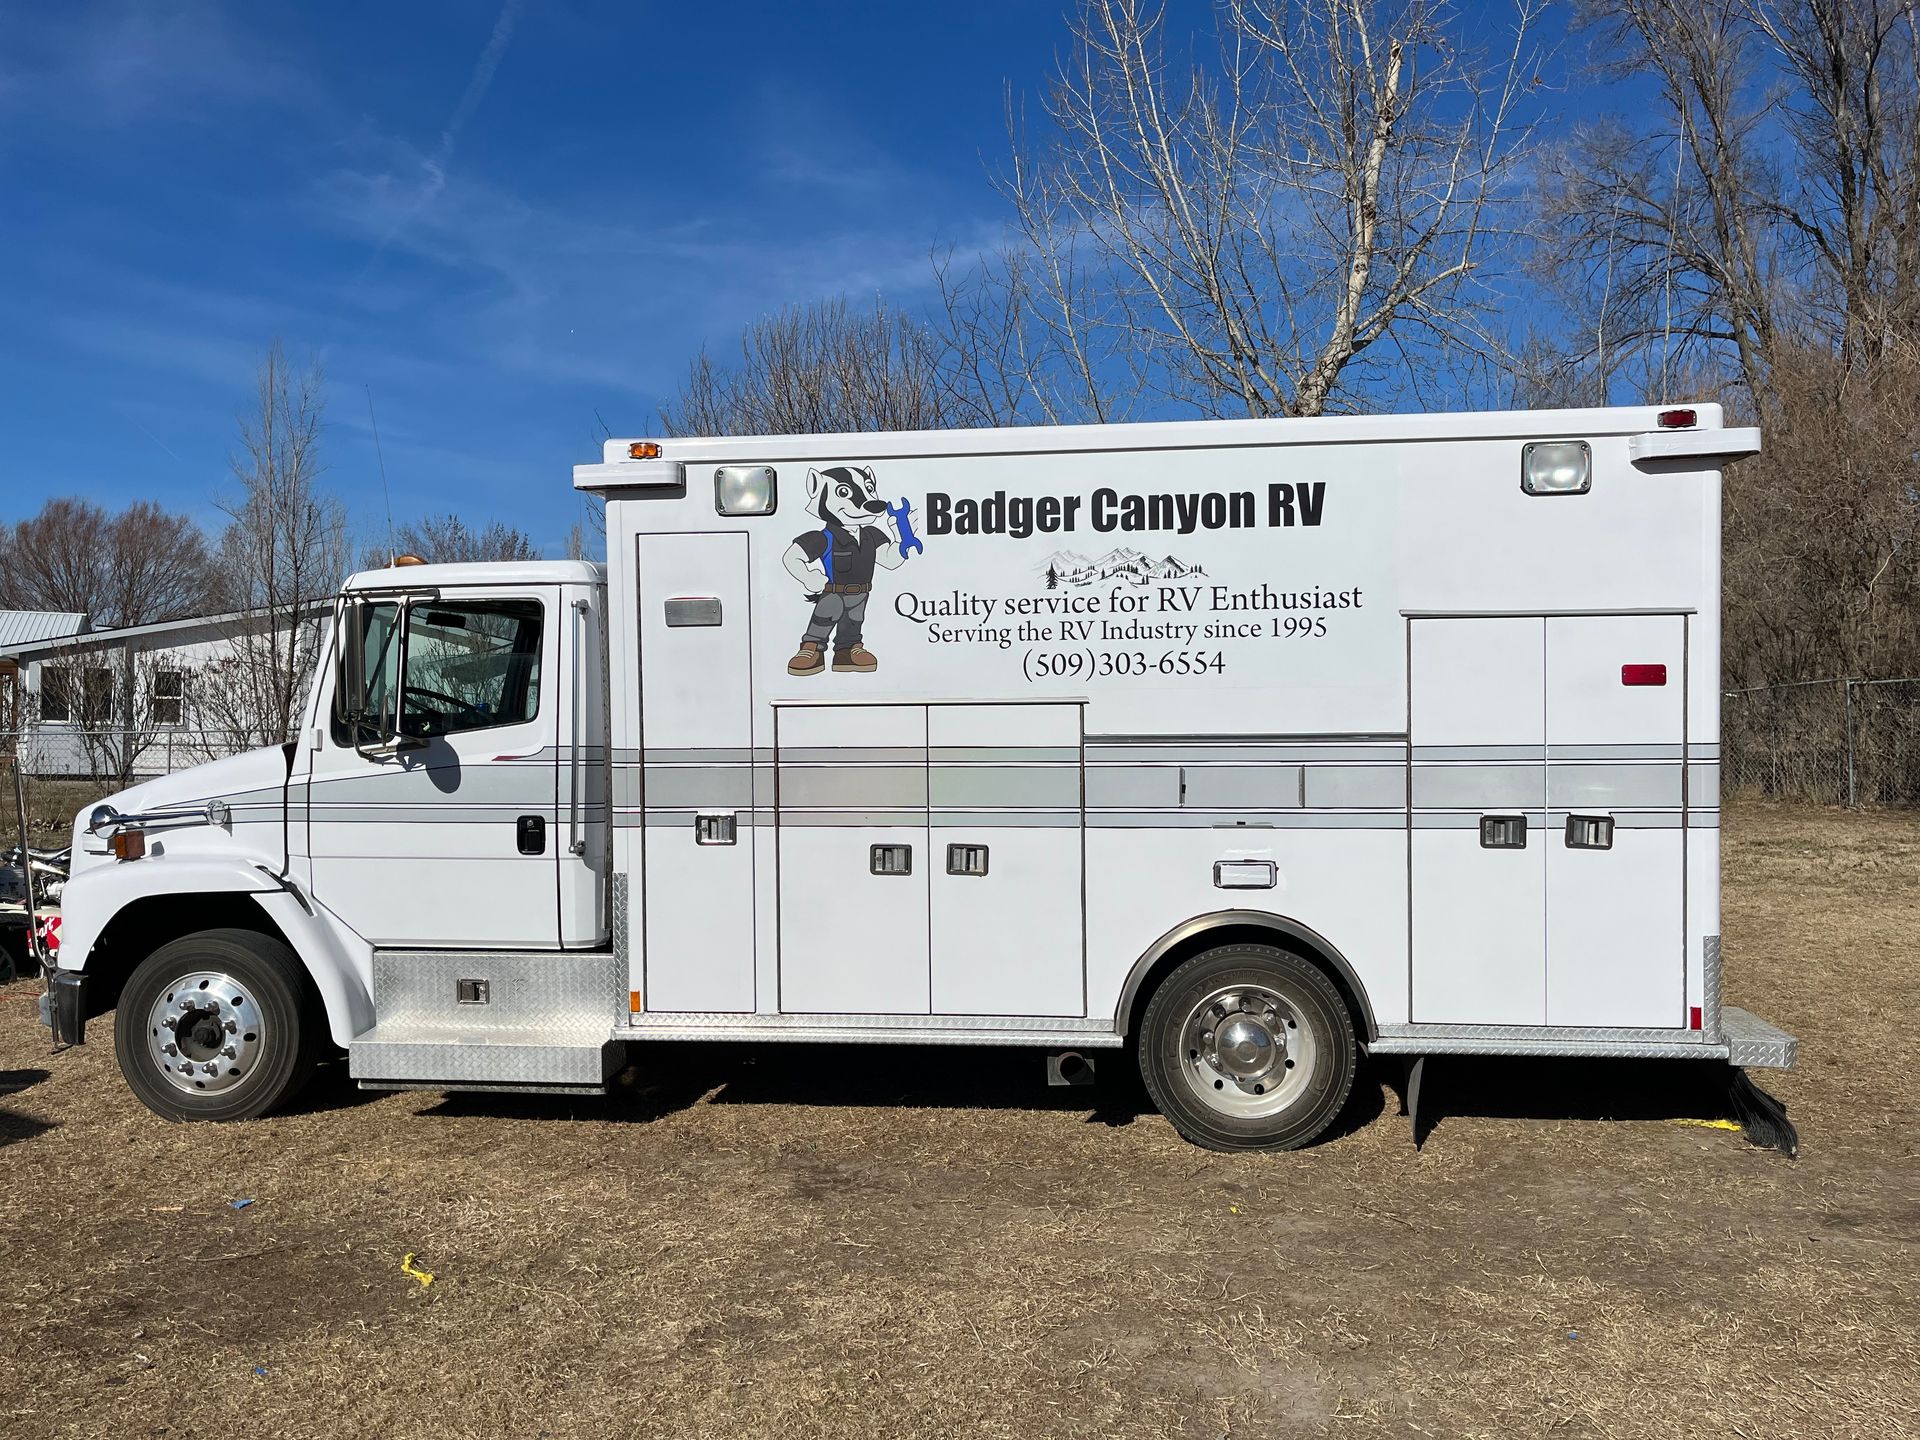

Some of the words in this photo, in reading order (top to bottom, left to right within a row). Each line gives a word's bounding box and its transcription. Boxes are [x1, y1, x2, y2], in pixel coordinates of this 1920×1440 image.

[926, 490, 1081, 539] Badger
[1091, 486, 1256, 535] Canyon
[1268, 481, 1327, 528] RV
[894, 590, 998, 625] Quality
[1004, 590, 1102, 615] service
[1108, 587, 1150, 613] for
[1157, 587, 1203, 612] RV
[1209, 583, 1364, 611] Enthusiast
[926, 621, 1012, 649] Serving
[1017, 620, 1053, 642] the
[1059, 620, 1095, 641] RV
[1100, 618, 1199, 646] Industry
[1203, 619, 1263, 640] since
[1271, 616, 1328, 639] 1995
[1022, 648, 1226, 682] (509)303-6554
